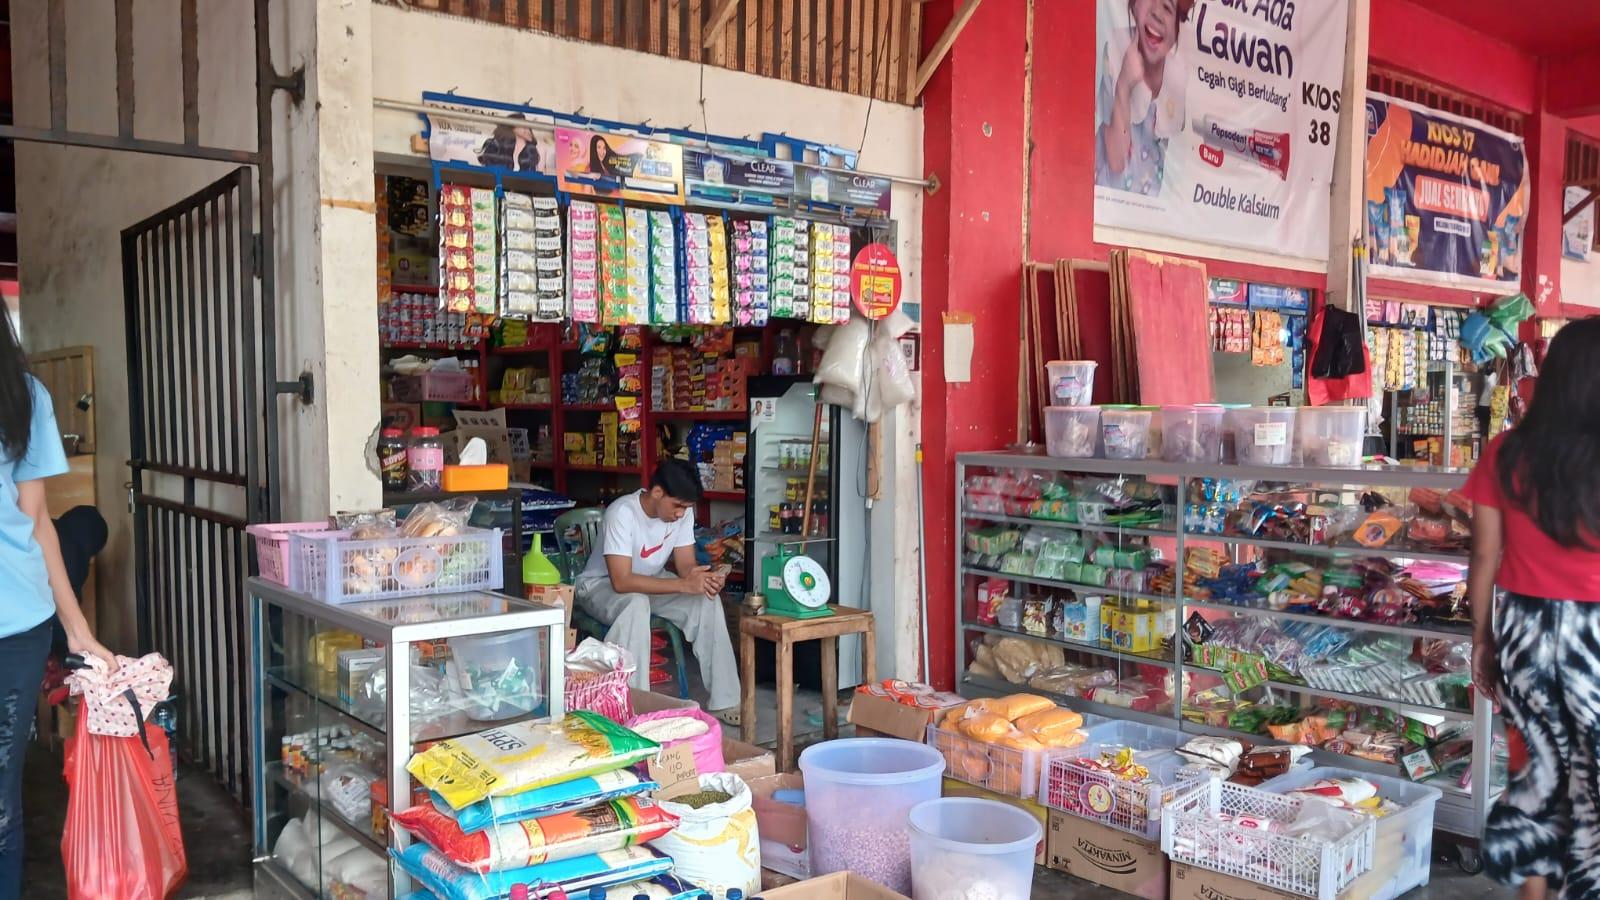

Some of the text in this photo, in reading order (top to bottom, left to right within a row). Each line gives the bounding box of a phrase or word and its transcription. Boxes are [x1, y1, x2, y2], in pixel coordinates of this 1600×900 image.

[1196, 3, 1293, 79] Lawan
[1198, 66, 1226, 90] Cegah
[1228, 76, 1246, 98] Gigi
[1302, 81, 1341, 114] KIOS
[1211, 122, 1247, 144] Pepsodent
[1308, 119, 1331, 146] 38
[1427, 120, 1475, 152] KIOS 37
[750, 159, 776, 174] CLEAR
[1203, 148, 1219, 164] Baru
[1400, 139, 1469, 176] HADIDJAH
[853, 176, 876, 189] CLEAR
[1420, 178, 1442, 207] JUAL
[1193, 183, 1236, 211] Double
[1238, 192, 1280, 220] Kalsium
[651, 753, 681, 766] KCANG
[1077, 837, 1132, 863] MINYAKITA
